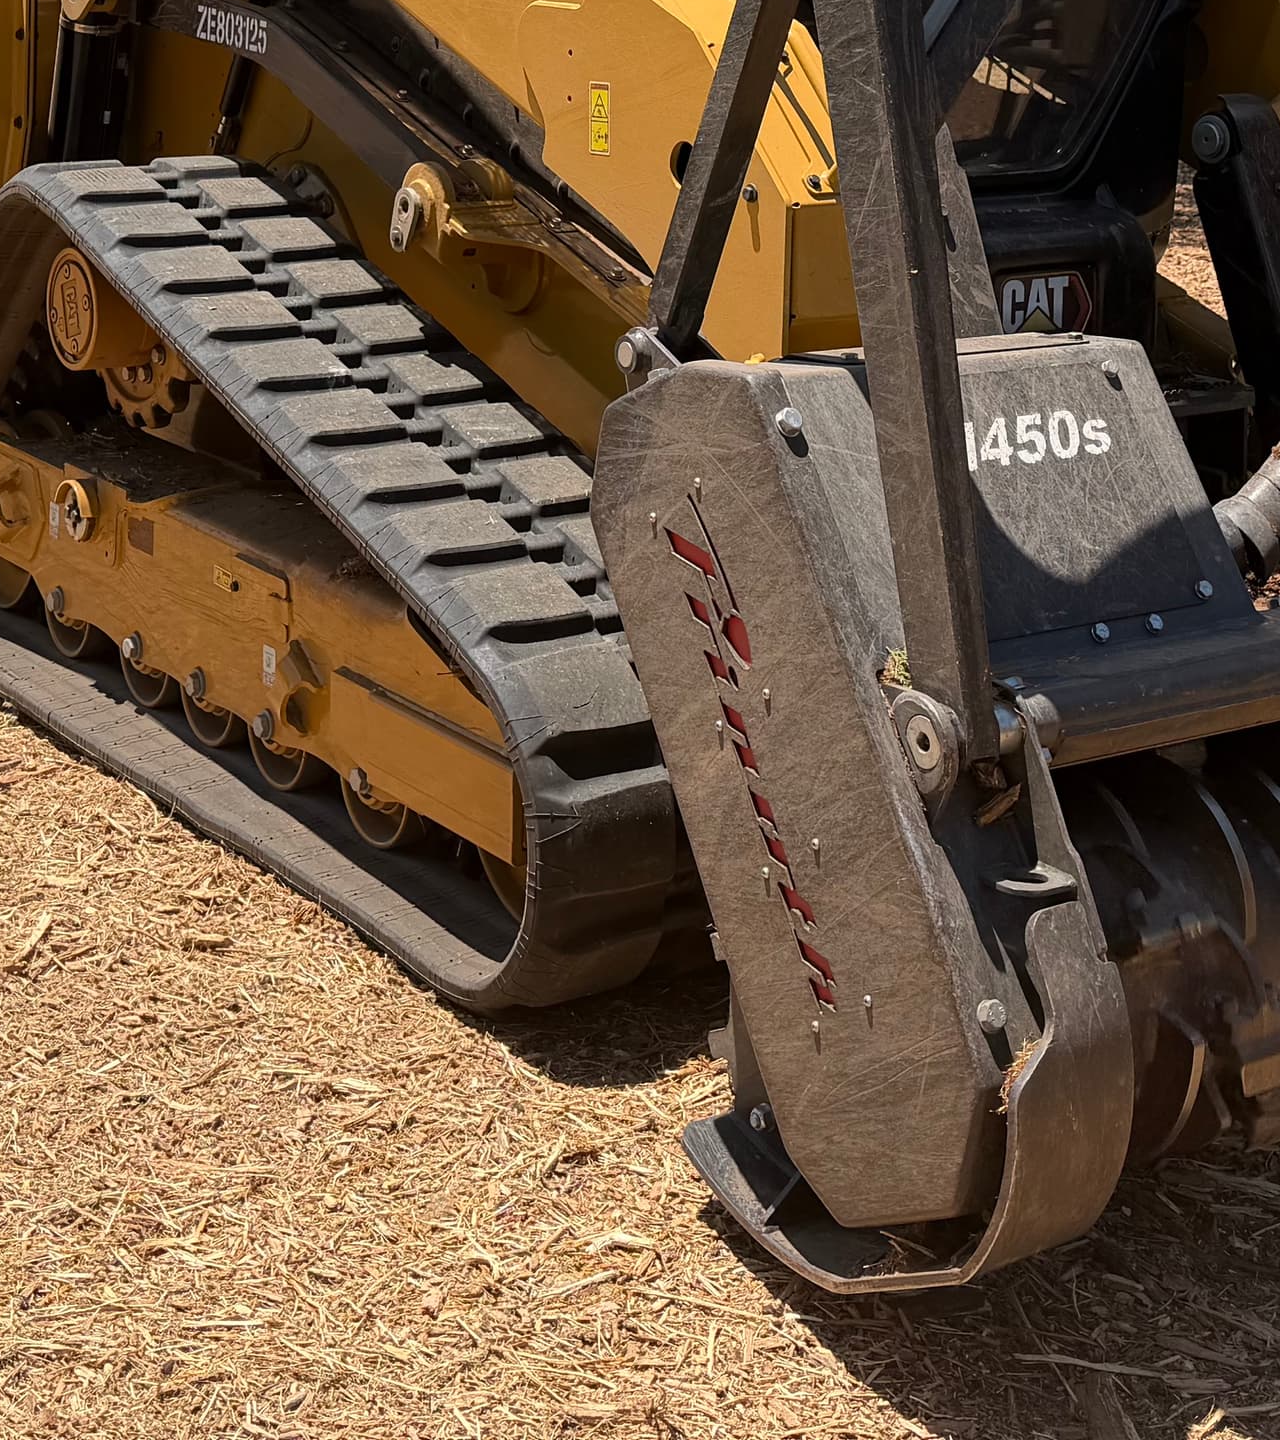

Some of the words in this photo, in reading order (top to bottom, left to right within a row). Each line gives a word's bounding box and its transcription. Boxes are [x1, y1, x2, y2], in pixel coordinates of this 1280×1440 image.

[196, 4, 268, 54] ZE803125
[1002, 275, 1070, 334] CAT
[963, 410, 1112, 472] 450s
